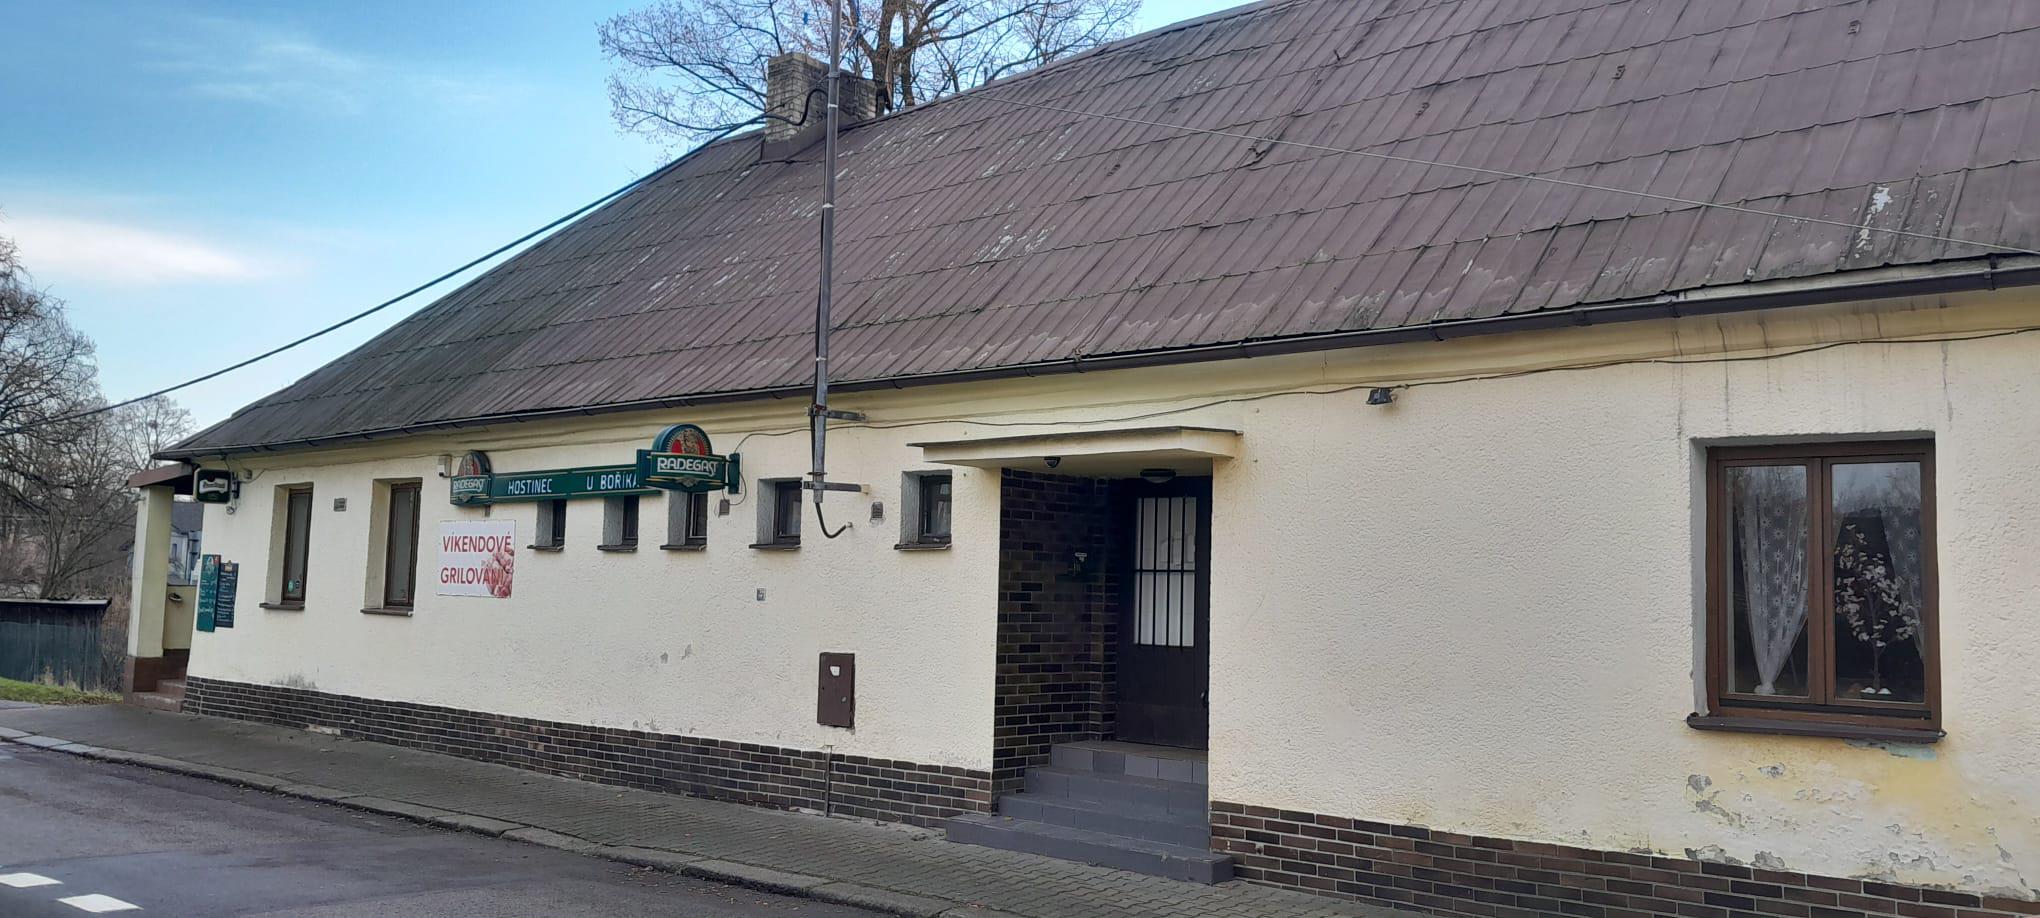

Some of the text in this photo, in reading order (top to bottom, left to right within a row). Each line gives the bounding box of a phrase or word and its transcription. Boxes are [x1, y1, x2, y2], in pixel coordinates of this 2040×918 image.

[657, 457, 718, 477] RADEGAST
[452, 478, 486, 493] RADEGAST
[507, 478, 553, 495] HOSTINEC
[586, 475, 594, 490] U
[442, 531, 512, 553] VÍKENDOVÉ
